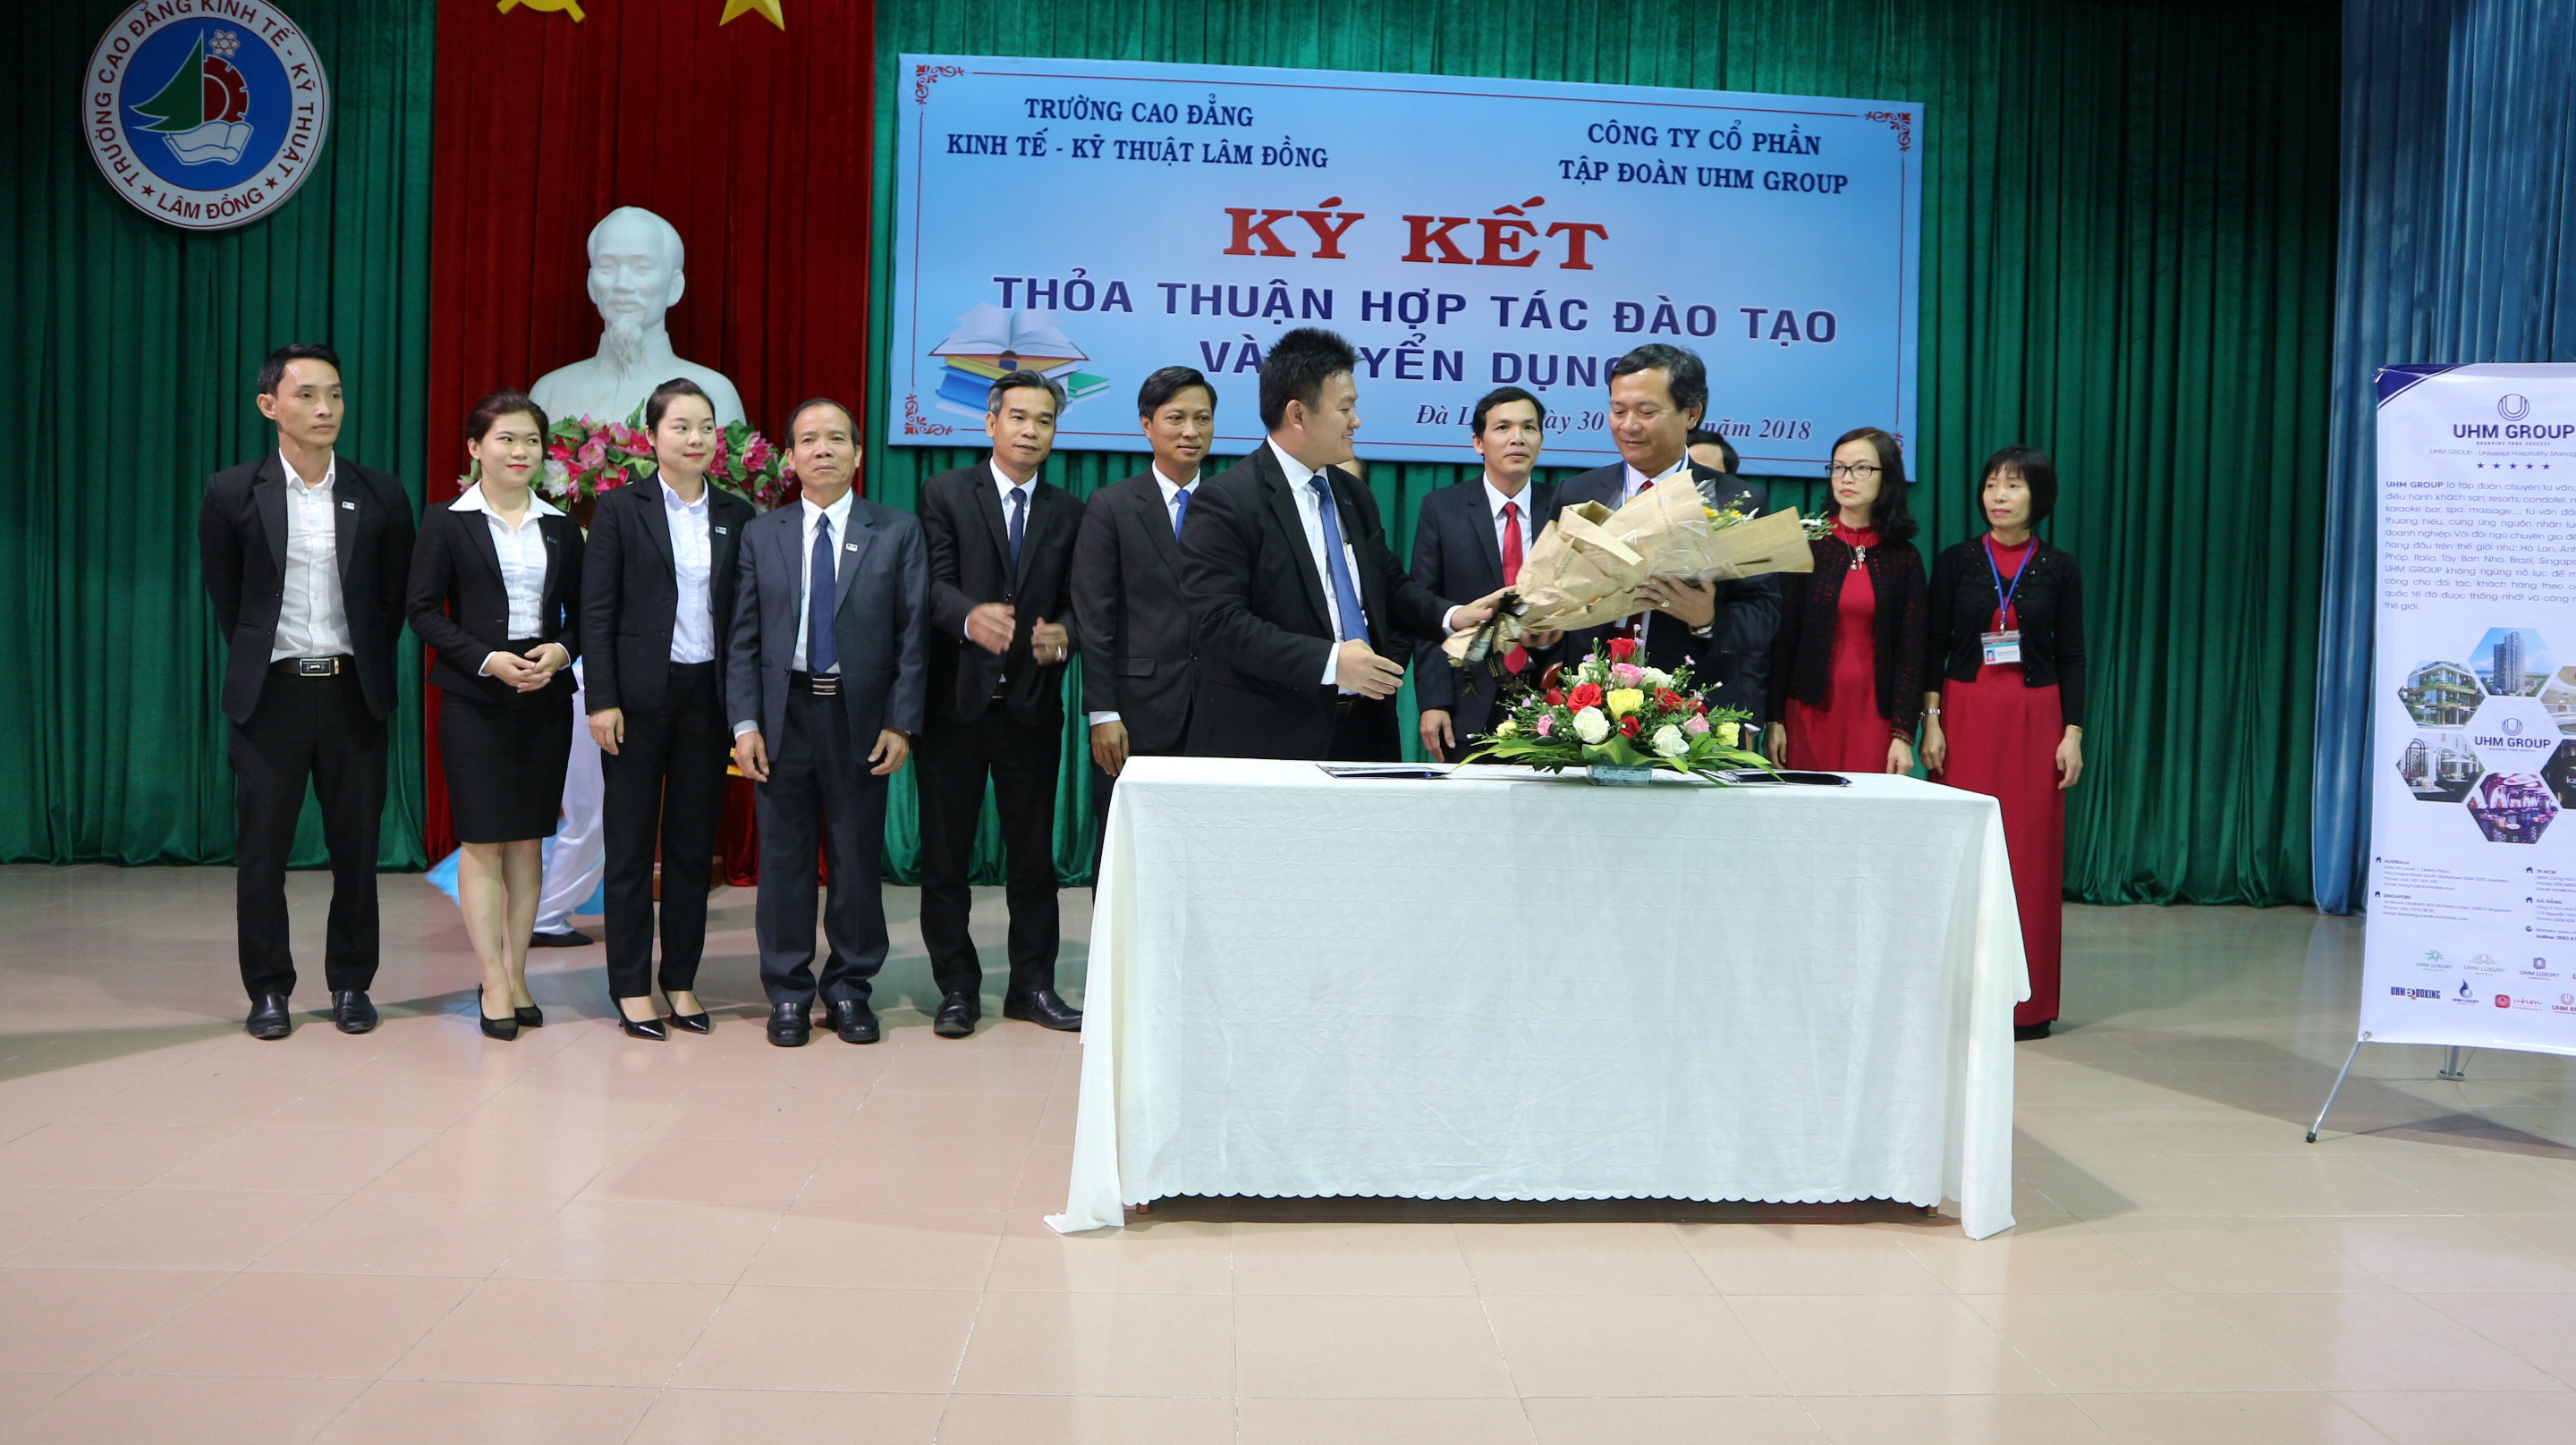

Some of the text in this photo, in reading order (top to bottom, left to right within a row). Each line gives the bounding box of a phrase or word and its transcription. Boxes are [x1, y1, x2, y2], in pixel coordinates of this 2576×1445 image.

[200, 0, 258, 24] KINH
[265, 17, 296, 48] TẾ
[98, 36, 131, 84] CAO
[291, 62, 317, 93] KỸ
[1024, 93, 1254, 127] TRƯỜNG CAO ĐẲNG
[95, 91, 140, 188] TRƯỜNG
[276, 101, 315, 179] THUẬT
[946, 133, 1008, 156] KINH
[1015, 127, 1050, 157] TẾ
[1072, 132, 1106, 159] KỸ
[1114, 139, 1195, 167] THUẬT
[1202, 139, 1253, 165] LÂM
[1261, 135, 1329, 169] ĐỒNG
[1587, 119, 1822, 156] CÔNG TY CỔ PHẦN
[1558, 154, 1850, 195] TẬP ĐOÀN UHM GROUP
[157, 186, 265, 220] LÂM ĐỒNG
[1223, 195, 1610, 271] KÝ KẾT
[993, 267, 1838, 349] THỎA THUẬN HỢP TÁC ĐÀO TẠO
[1199, 334, 1262, 376] VÀ
[1352, 333, 1464, 382] YỂN
[1416, 404, 1449, 426] Đà
[1577, 410, 1606, 431] 30
[1758, 418, 1812, 441] 2018
[2453, 424, 2576, 439] UHM GROUP
[2512, 450, 2548, 459] Hospitality
[2504, 483, 2541, 493] chuyên
[2385, 504, 2422, 512] karaoke
[2425, 505, 2443, 514] bar,
[2445, 507, 2466, 515] spa,
[2385, 528, 2416, 537] doanh
[2547, 533, 2563, 542] gia
[2449, 519, 2474, 528] cung
[2385, 541, 2410, 551] hàng
[2457, 542, 2474, 550] thế
[2385, 553, 2411, 562] Pháp,
[2385, 565, 2406, 573] UHM
[2409, 565, 2443, 574] GROUP
[2446, 567, 2477, 577] không
[2385, 578, 2409, 587] công
[2477, 579, 2507, 588] khách
[2512, 581, 2538, 590] hàng
[2541, 581, 2564, 589] theo
[2385, 589, 2409, 598] quốc
[2470, 591, 2498, 602] thống
[2544, 594, 2570, 604] công
[2474, 736, 2551, 748] UHM GROUP
[2480, 966, 2506, 974] LUXURY
[2390, 986, 2406, 997] UHM
